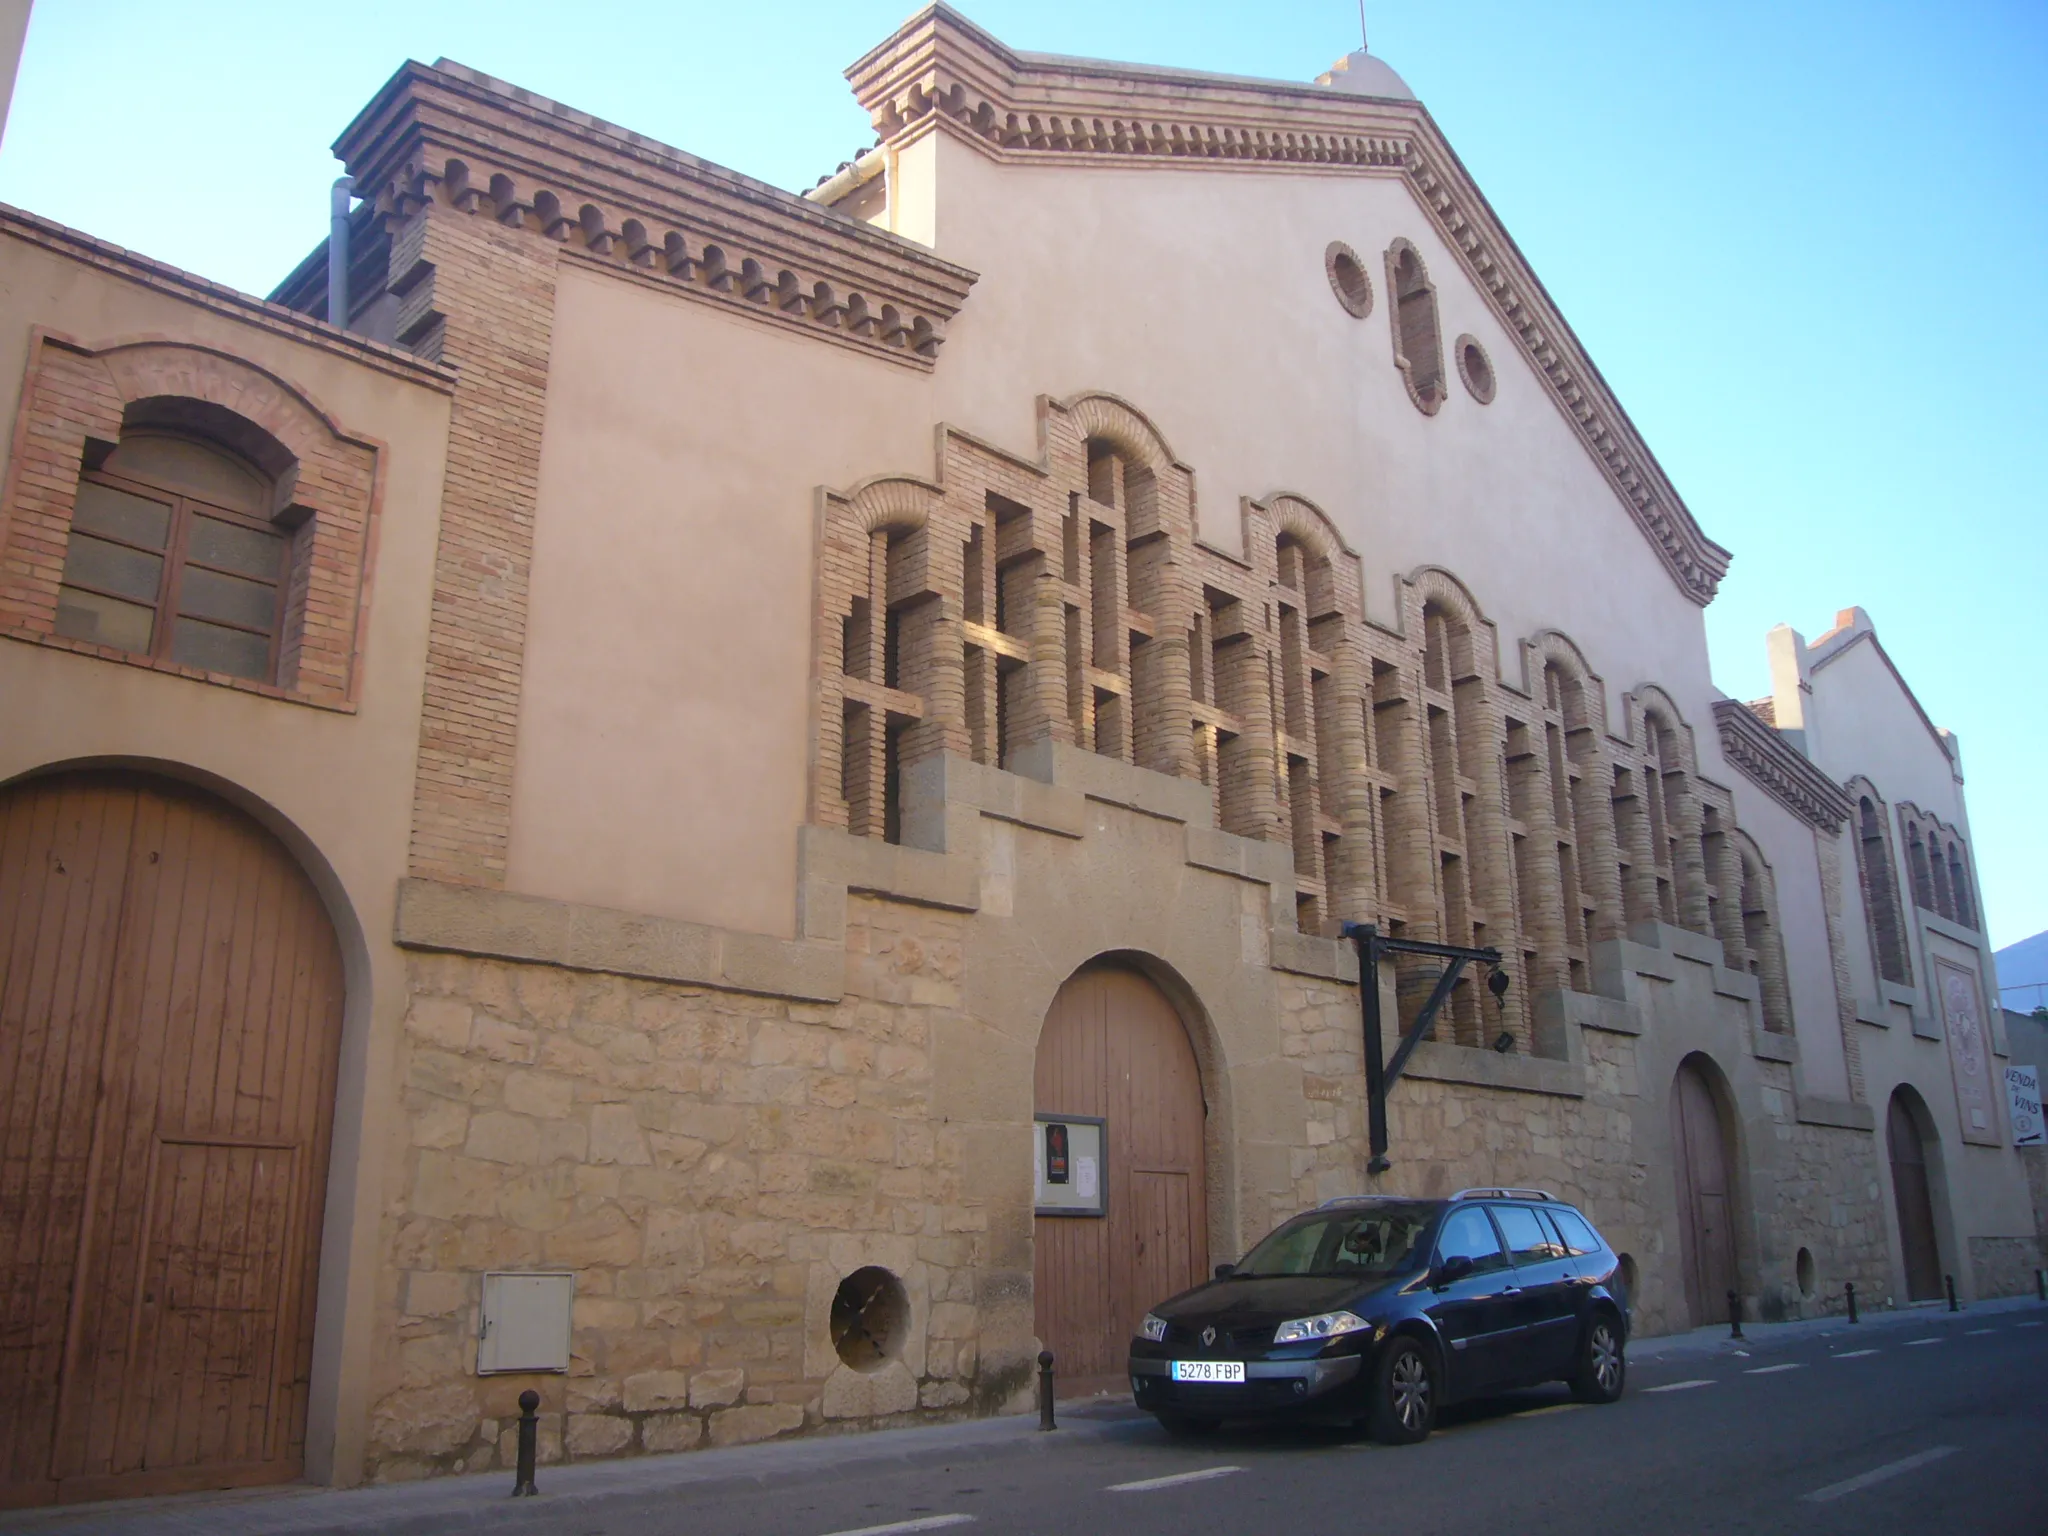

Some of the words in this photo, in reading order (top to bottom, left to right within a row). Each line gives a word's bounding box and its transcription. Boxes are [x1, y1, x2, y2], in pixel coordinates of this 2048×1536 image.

[2005, 1068, 2036, 1090] VENDA
[2015, 1095, 2039, 1114] VINS
[1180, 1363, 1211, 1378] 5278
[1216, 1363, 1241, 1379] FBP
